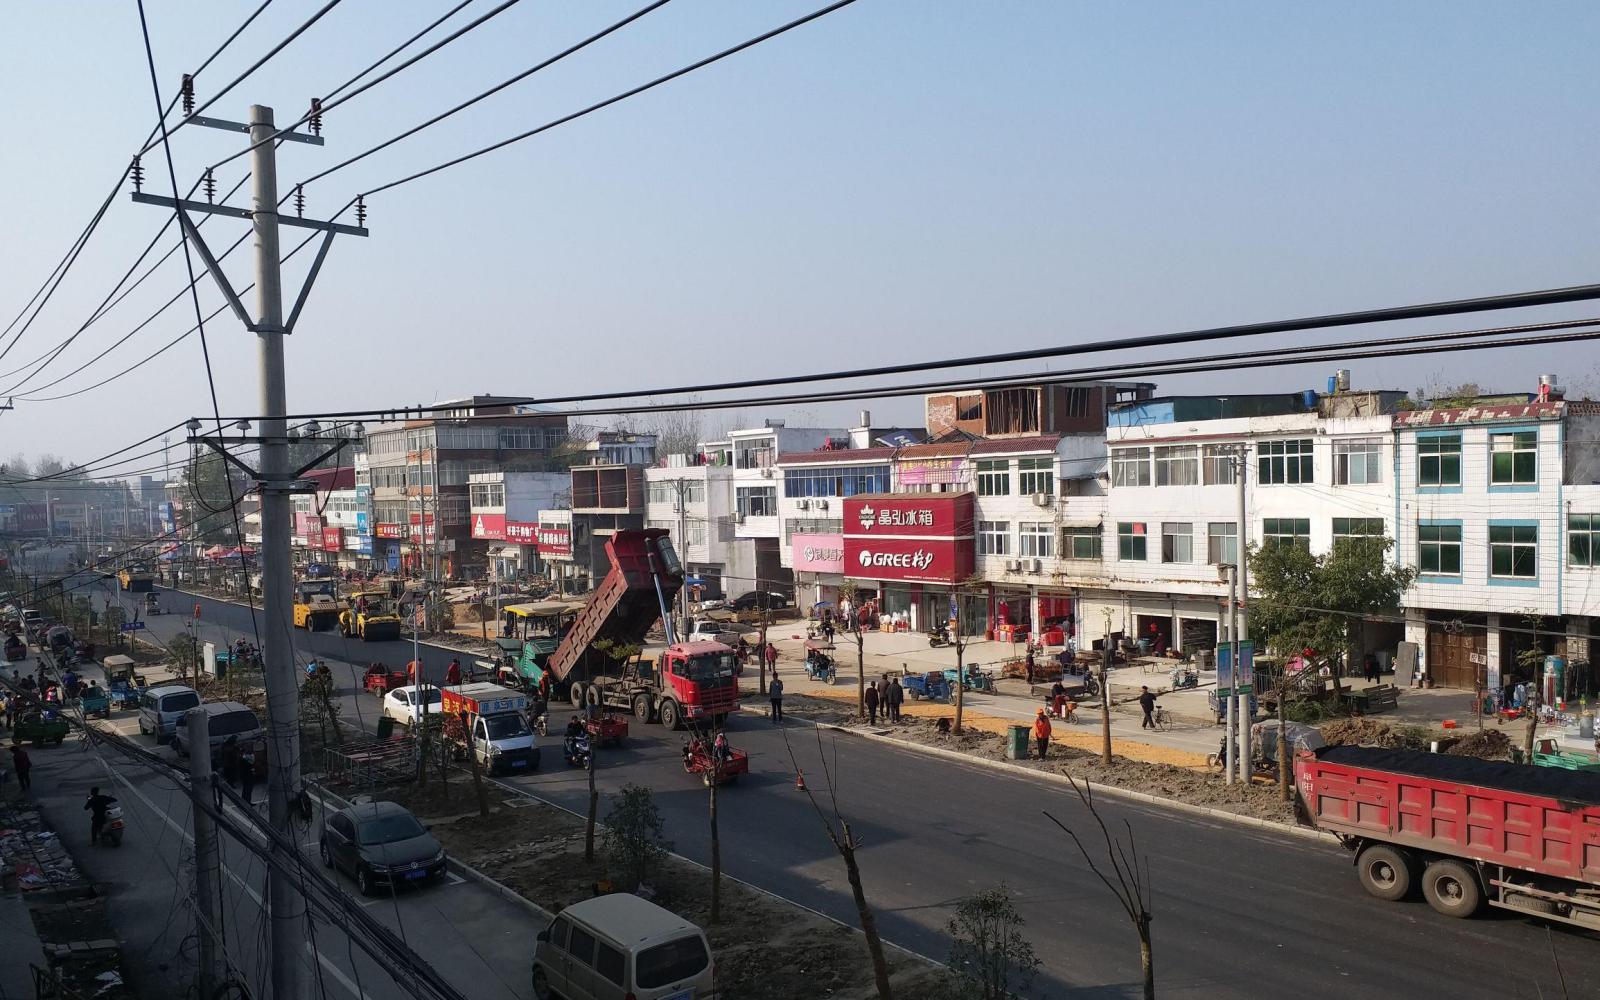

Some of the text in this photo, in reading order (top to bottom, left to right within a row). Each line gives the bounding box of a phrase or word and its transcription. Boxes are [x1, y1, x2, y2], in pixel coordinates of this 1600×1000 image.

[879, 510, 933, 526] 晶弘冰箱
[873, 553, 911, 567] GREE
